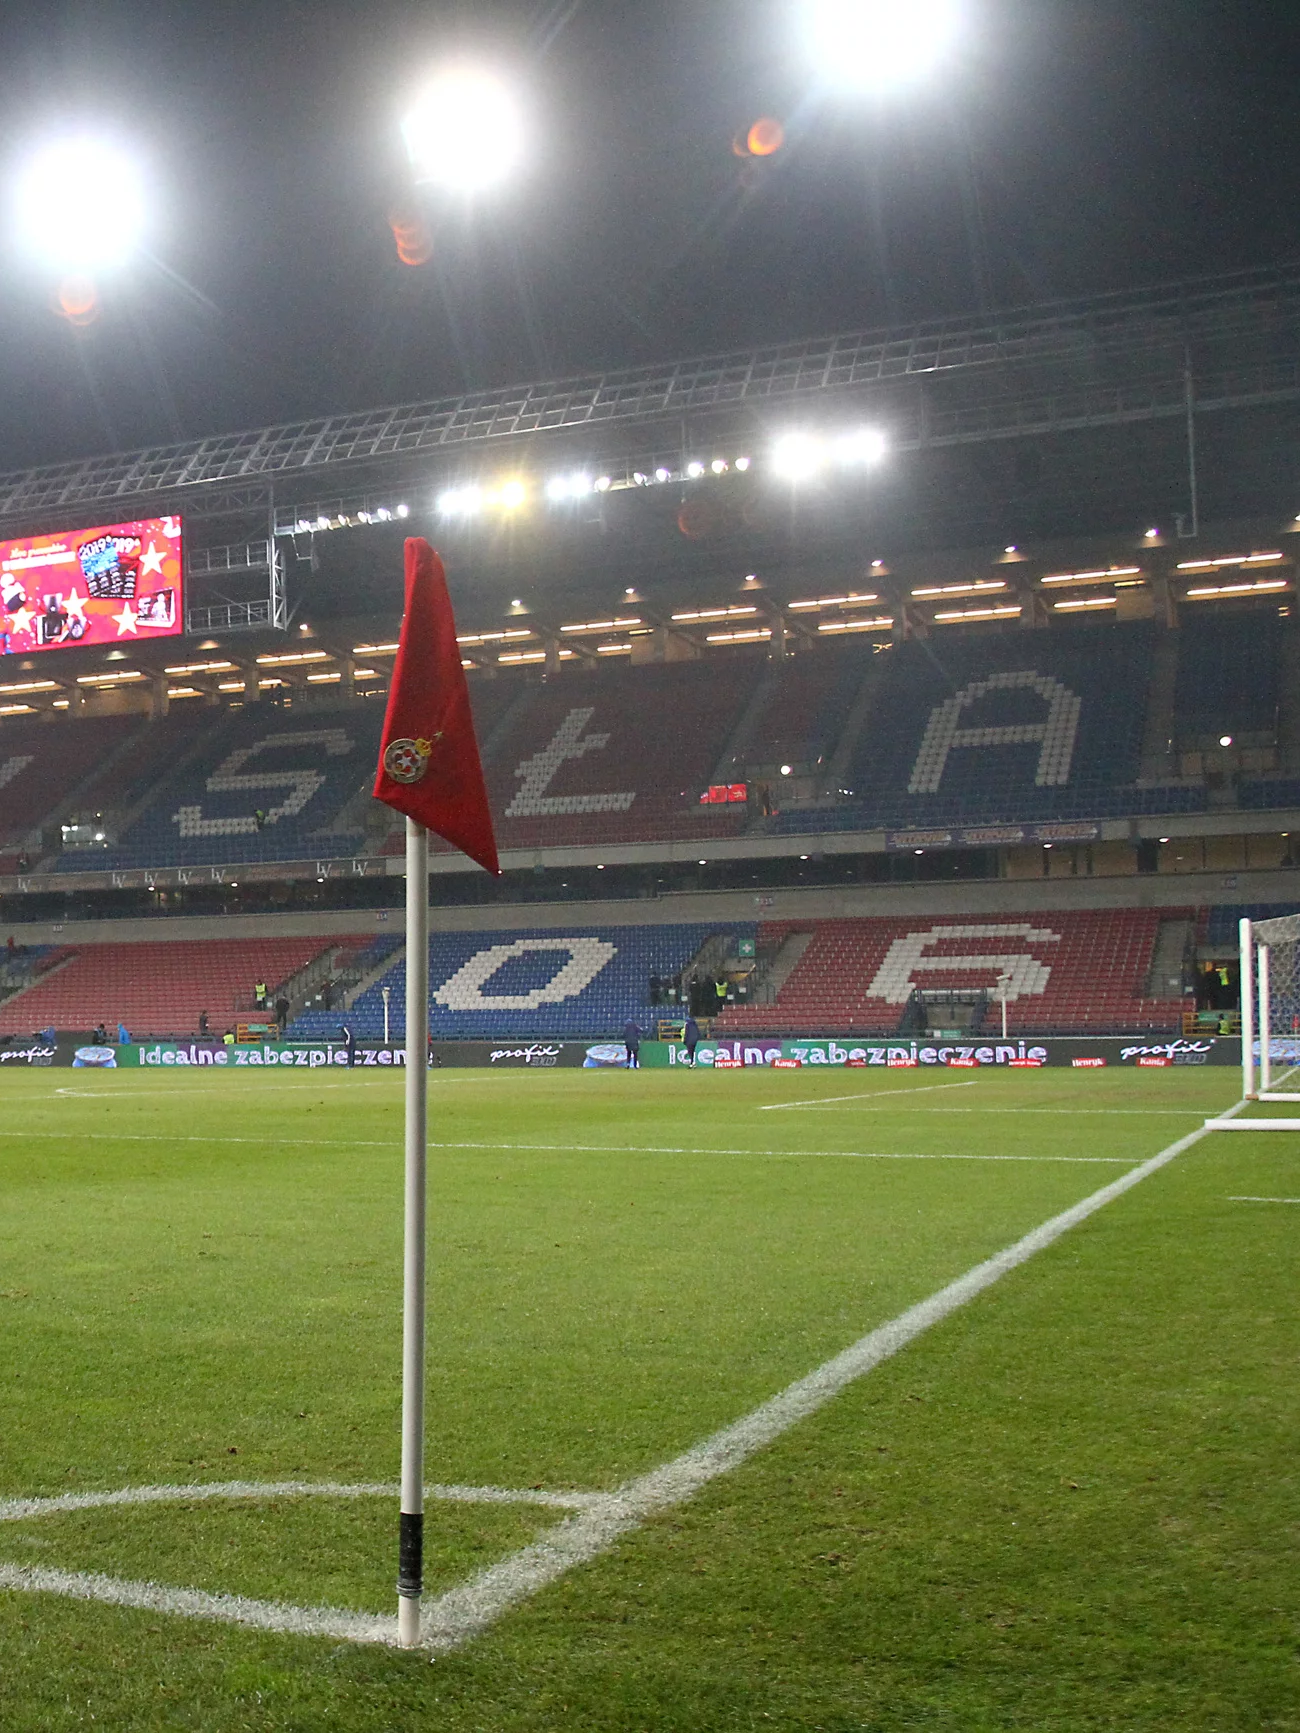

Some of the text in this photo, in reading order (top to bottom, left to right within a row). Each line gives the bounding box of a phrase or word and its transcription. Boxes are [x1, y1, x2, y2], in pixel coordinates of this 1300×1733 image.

[139, 1044, 228, 1065] Idealne
[887, 1058, 916, 1067] Henryk
[1072, 1058, 1104, 1067] Henryk
